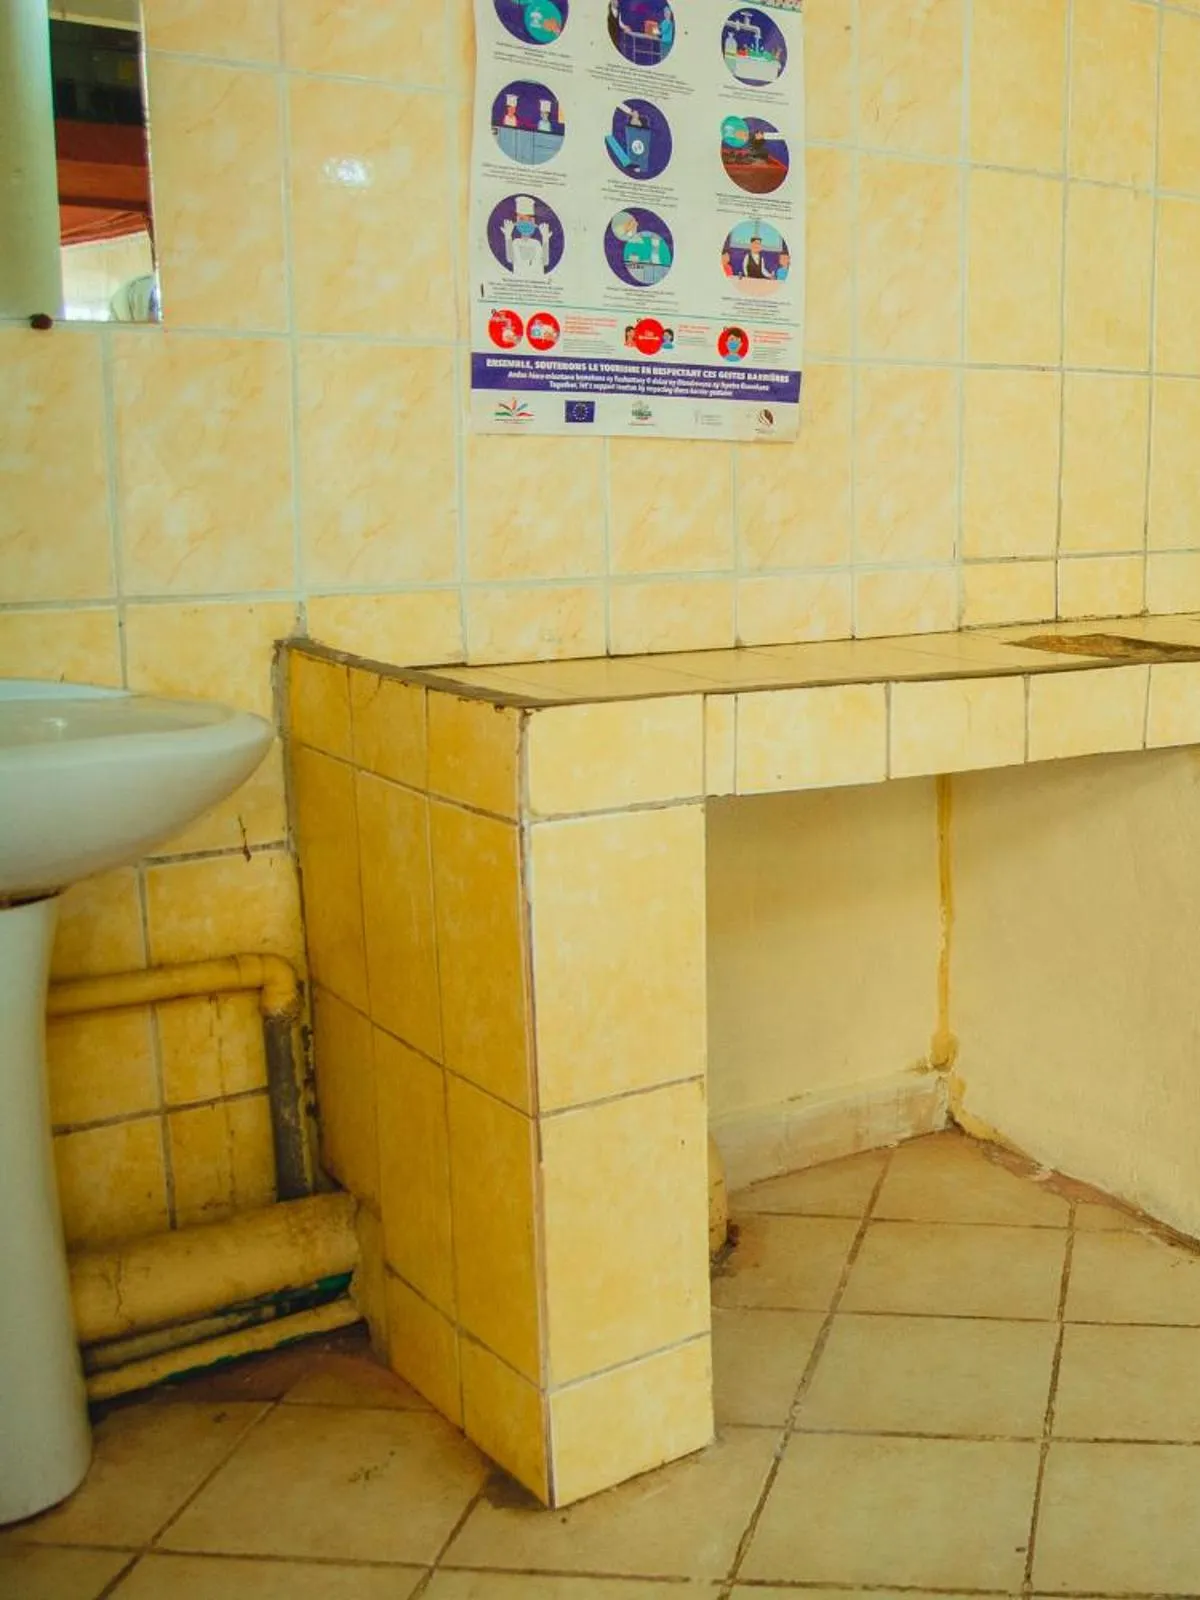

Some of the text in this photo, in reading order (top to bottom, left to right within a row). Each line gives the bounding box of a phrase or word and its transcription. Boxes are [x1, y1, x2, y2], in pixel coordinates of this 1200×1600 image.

[588, 363, 598, 372] LE
[641, 366, 651, 375] EN
[703, 370, 717, 379] CES
